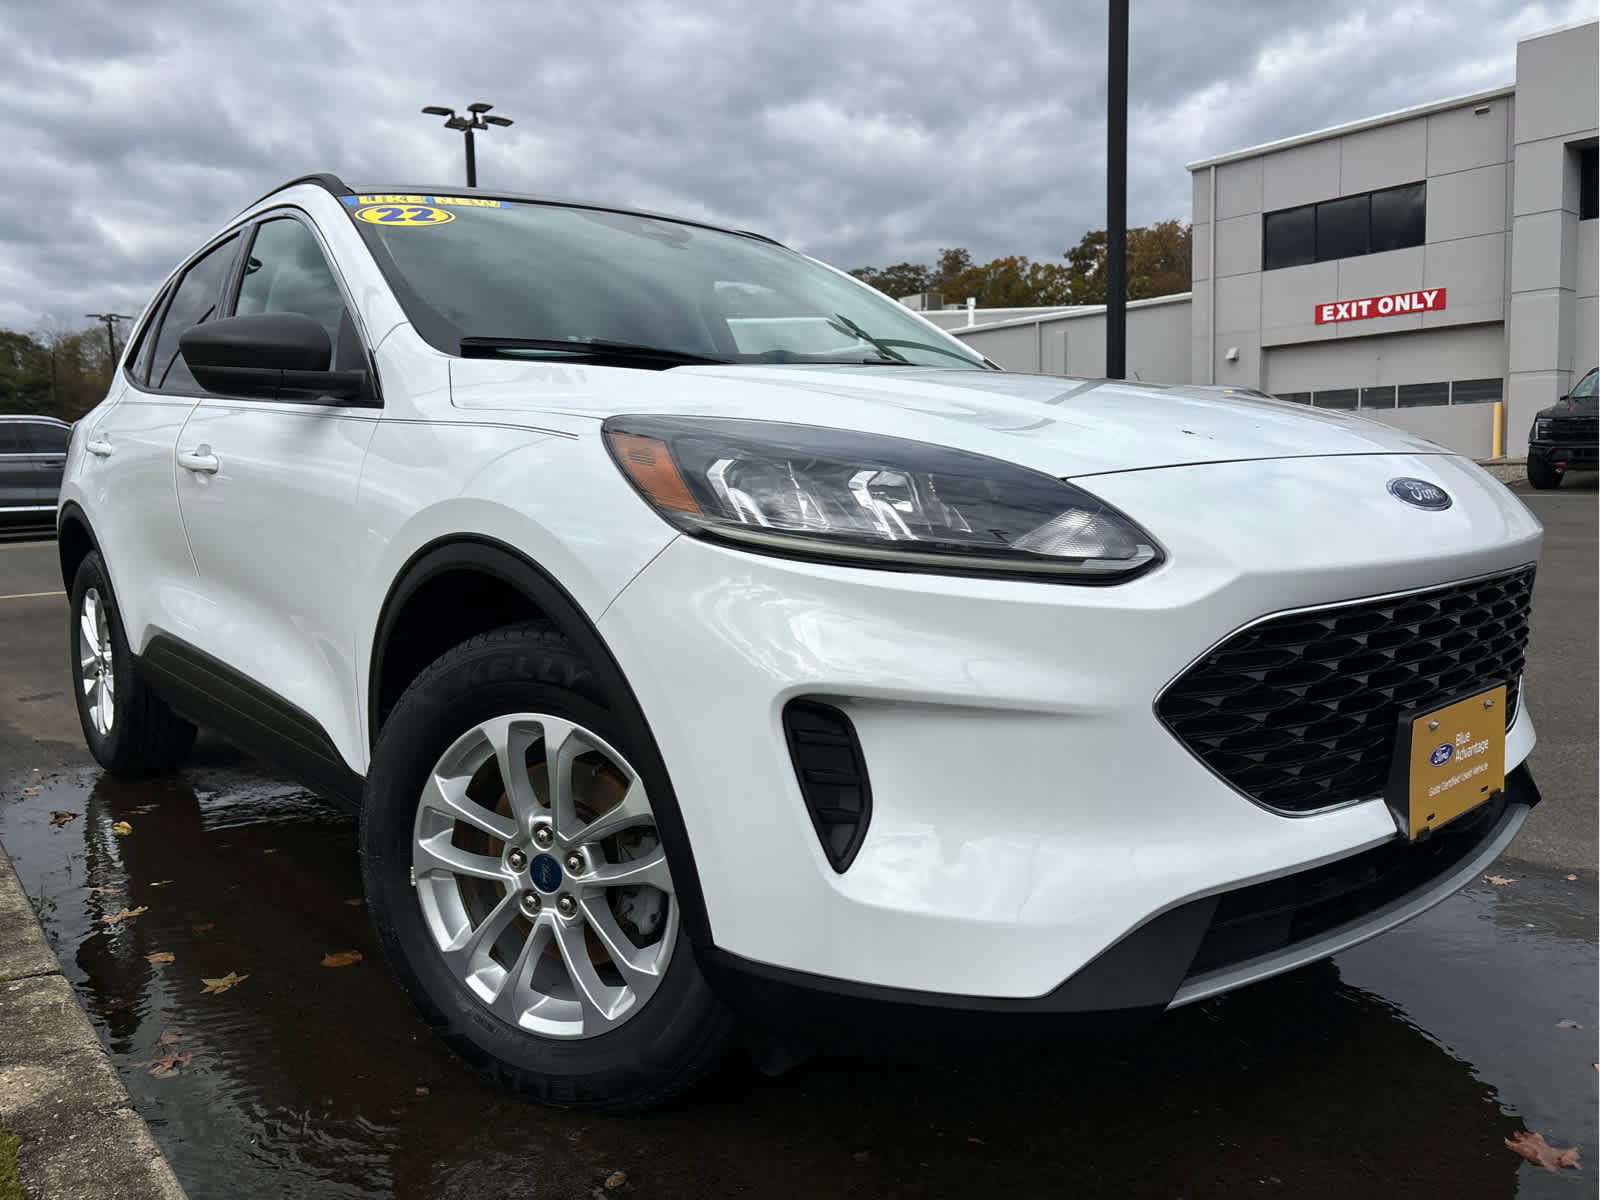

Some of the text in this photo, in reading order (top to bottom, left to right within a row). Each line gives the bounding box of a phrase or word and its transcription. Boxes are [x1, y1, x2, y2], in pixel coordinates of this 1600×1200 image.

[359, 195, 500, 208] LIKE NEW
[376, 207, 436, 222] 22
[1322, 290, 1439, 321] EXIT ONLY
[463, 655, 593, 688] KELLY
[1455, 731, 1471, 746] Blue
[1455, 739, 1489, 761] Advantage
